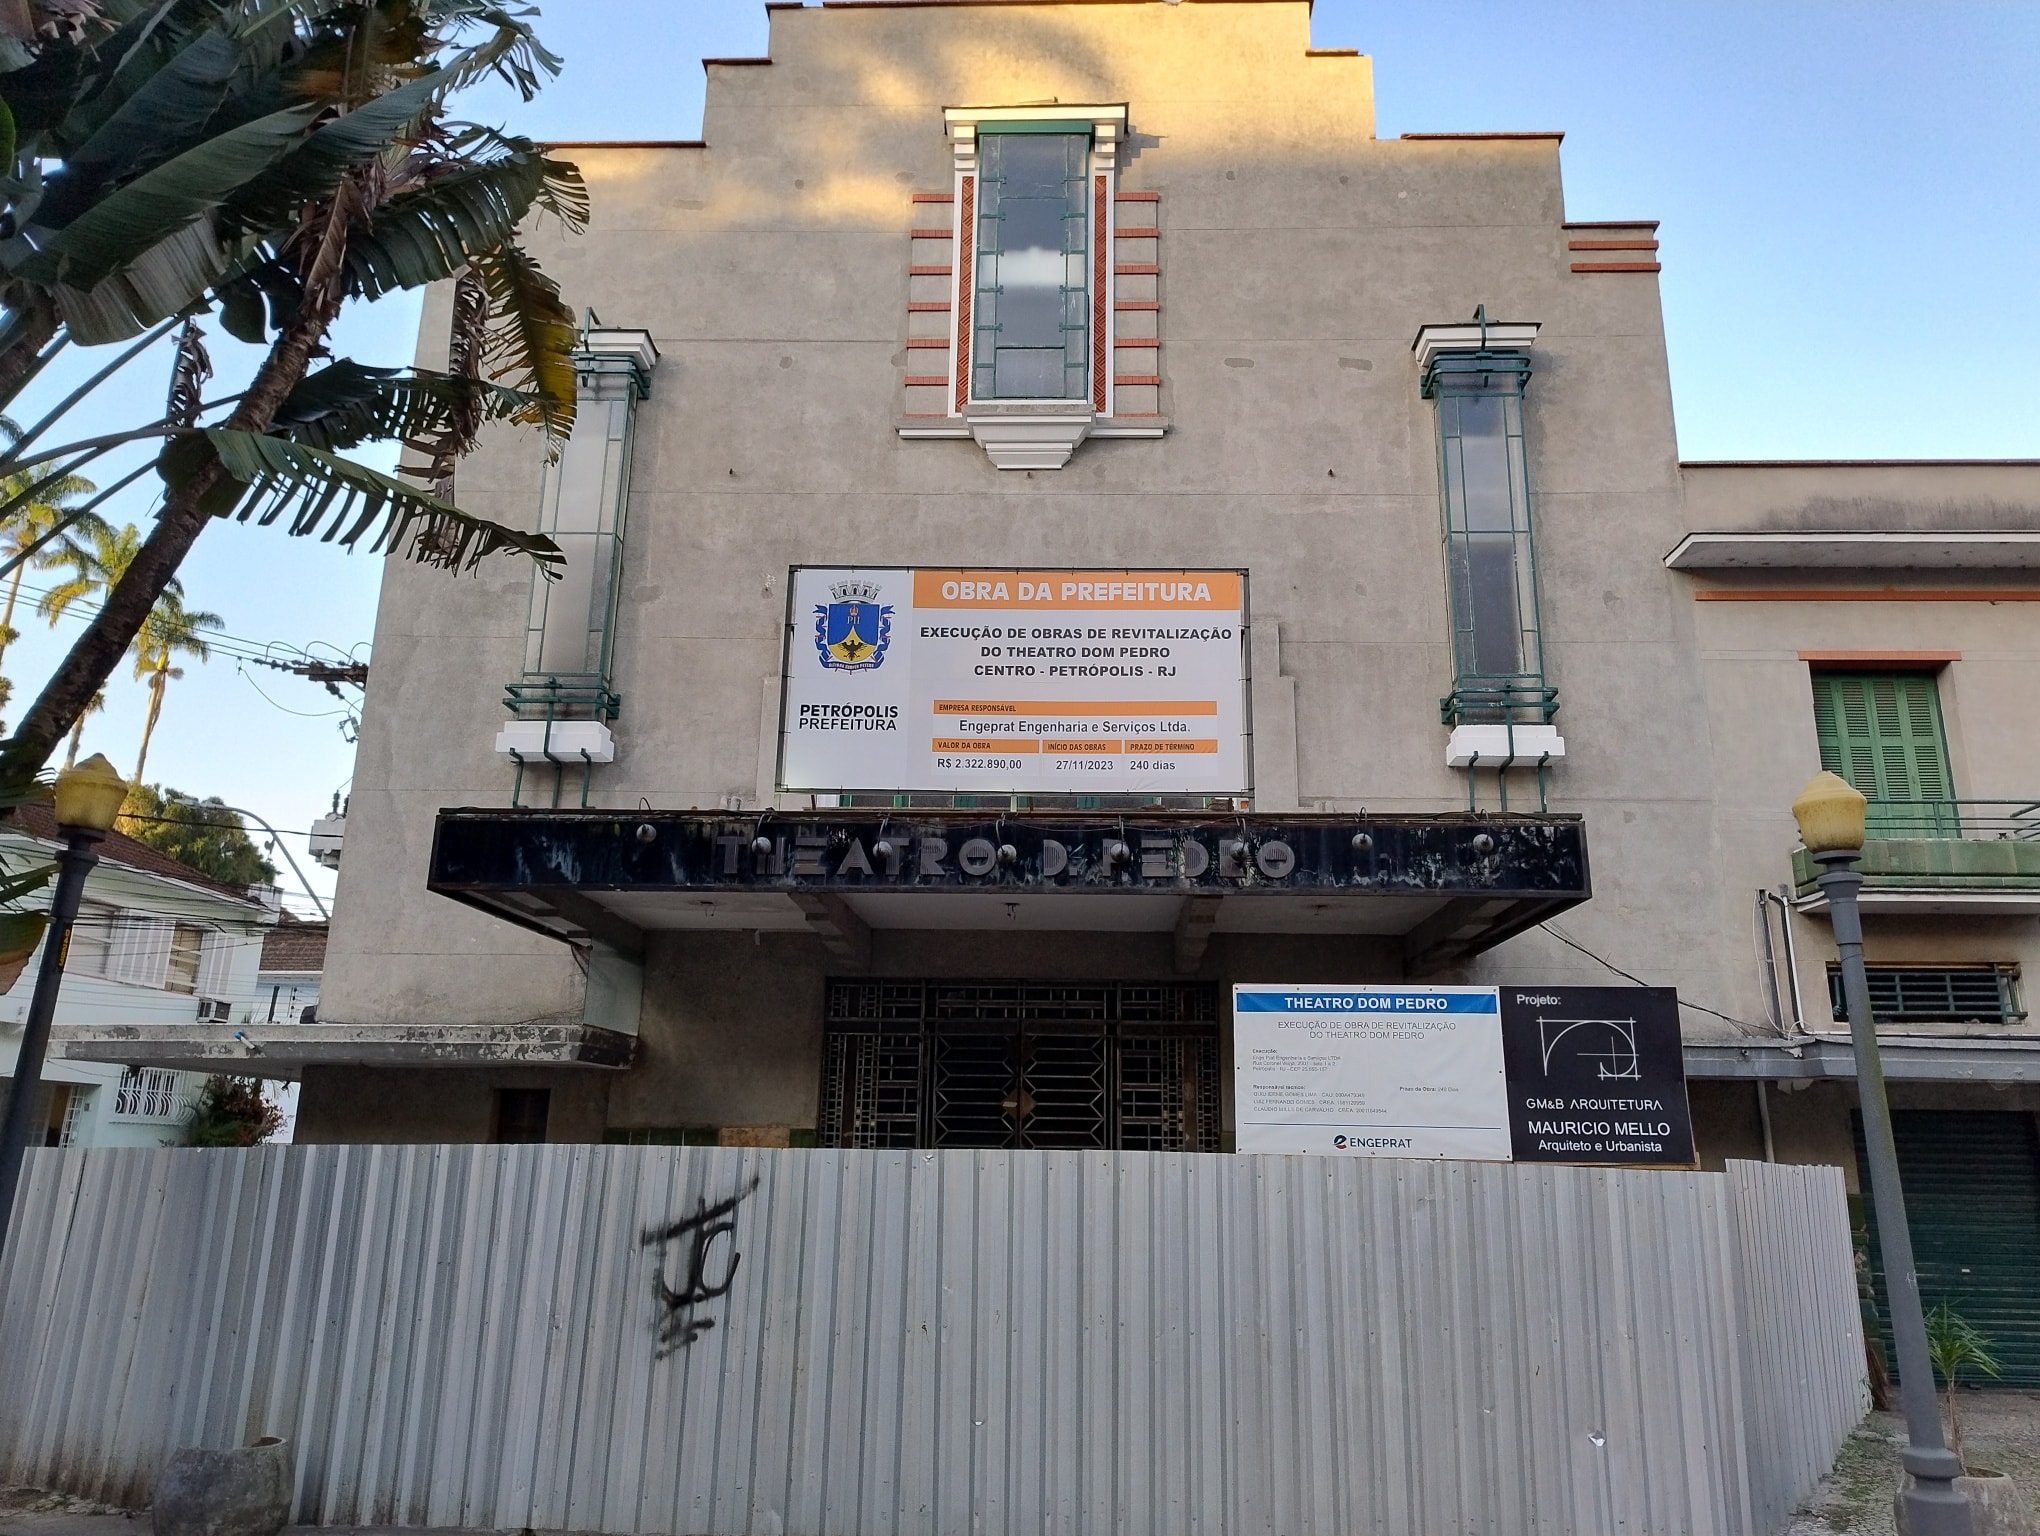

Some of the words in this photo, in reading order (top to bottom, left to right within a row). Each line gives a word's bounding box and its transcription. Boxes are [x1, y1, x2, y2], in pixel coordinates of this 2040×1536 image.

[942, 581, 1009, 600] OBRA
[1018, 582, 1052, 600] DA
[1061, 582, 1211, 601] PREFEITURA
[920, 626, 1002, 641] EXECUÇÃO
[1007, 628, 1027, 639] DE
[1031, 628, 1082, 639] OBRAS
[1087, 629, 1107, 639] DE
[1111, 626, 1232, 643] REVITALIZAÇÃO
[981, 646, 1001, 657] DO
[1007, 646, 1076, 658] THEATRO
[1081, 647, 1115, 658] DOM
[1120, 647, 1170, 658] PEDRO
[974, 665, 1036, 676] CENTRO
[1049, 663, 1144, 677] PETRÓPOLIS
[1158, 666, 1177, 677] RJ
[800, 702, 899, 718] PETRÓPOLIS
[939, 704, 969, 712] EMPRESA
[971, 704, 1017, 712] RESPONSÁVEL
[799, 718, 897, 731] PREFEITURA
[959, 720, 1015, 735] Engeprat
[1018, 721, 1088, 735] Engenharia
[1091, 723, 1099, 732] e
[1102, 721, 1156, 735] Serviços
[1160, 721, 1190, 732] Ltda.
[938, 741, 959, 749] VALOR
[1047, 742, 1067, 750] INÍCIO
[1069, 743, 1082, 751] DAS
[1084, 743, 1106, 751] OBRAS
[1130, 743, 1152, 751] PRAZO
[1154, 743, 1163, 751] DE
[937, 758, 951, 770] R$
[955, 758, 1022, 771] 2.322.890,00
[1055, 760, 1114, 770] 27/11/2023
[1130, 760, 1149, 770] 240
[1152, 760, 1175, 770] dias
[717, 836, 997, 876] THEATRO
[1285, 997, 1353, 1009] THEATRO
[1358, 998, 1391, 1009] DOM
[1396, 999, 1448, 1010] PEDRO
[1516, 994, 1561, 1007] Projeto:
[1278, 1020, 1327, 1030] EXECUÇÃO
[1386, 1021, 1456, 1031] REVITALIZAÇÃO
[1326, 1031, 1367, 1039] THEATRO
[1526, 1098, 1564, 1109] GM&B
[1570, 1099, 1663, 1110] ARQUITETURA
[1528, 1121, 1610, 1136] MAURICIO
[1615, 1122, 1670, 1136] MELLO
[1350, 1137, 1412, 1149] ENGEPRAT
[1538, 1139, 1591, 1153] Arquiteto
[1595, 1143, 1602, 1151] e
[1606, 1141, 1662, 1152] Urbanista
